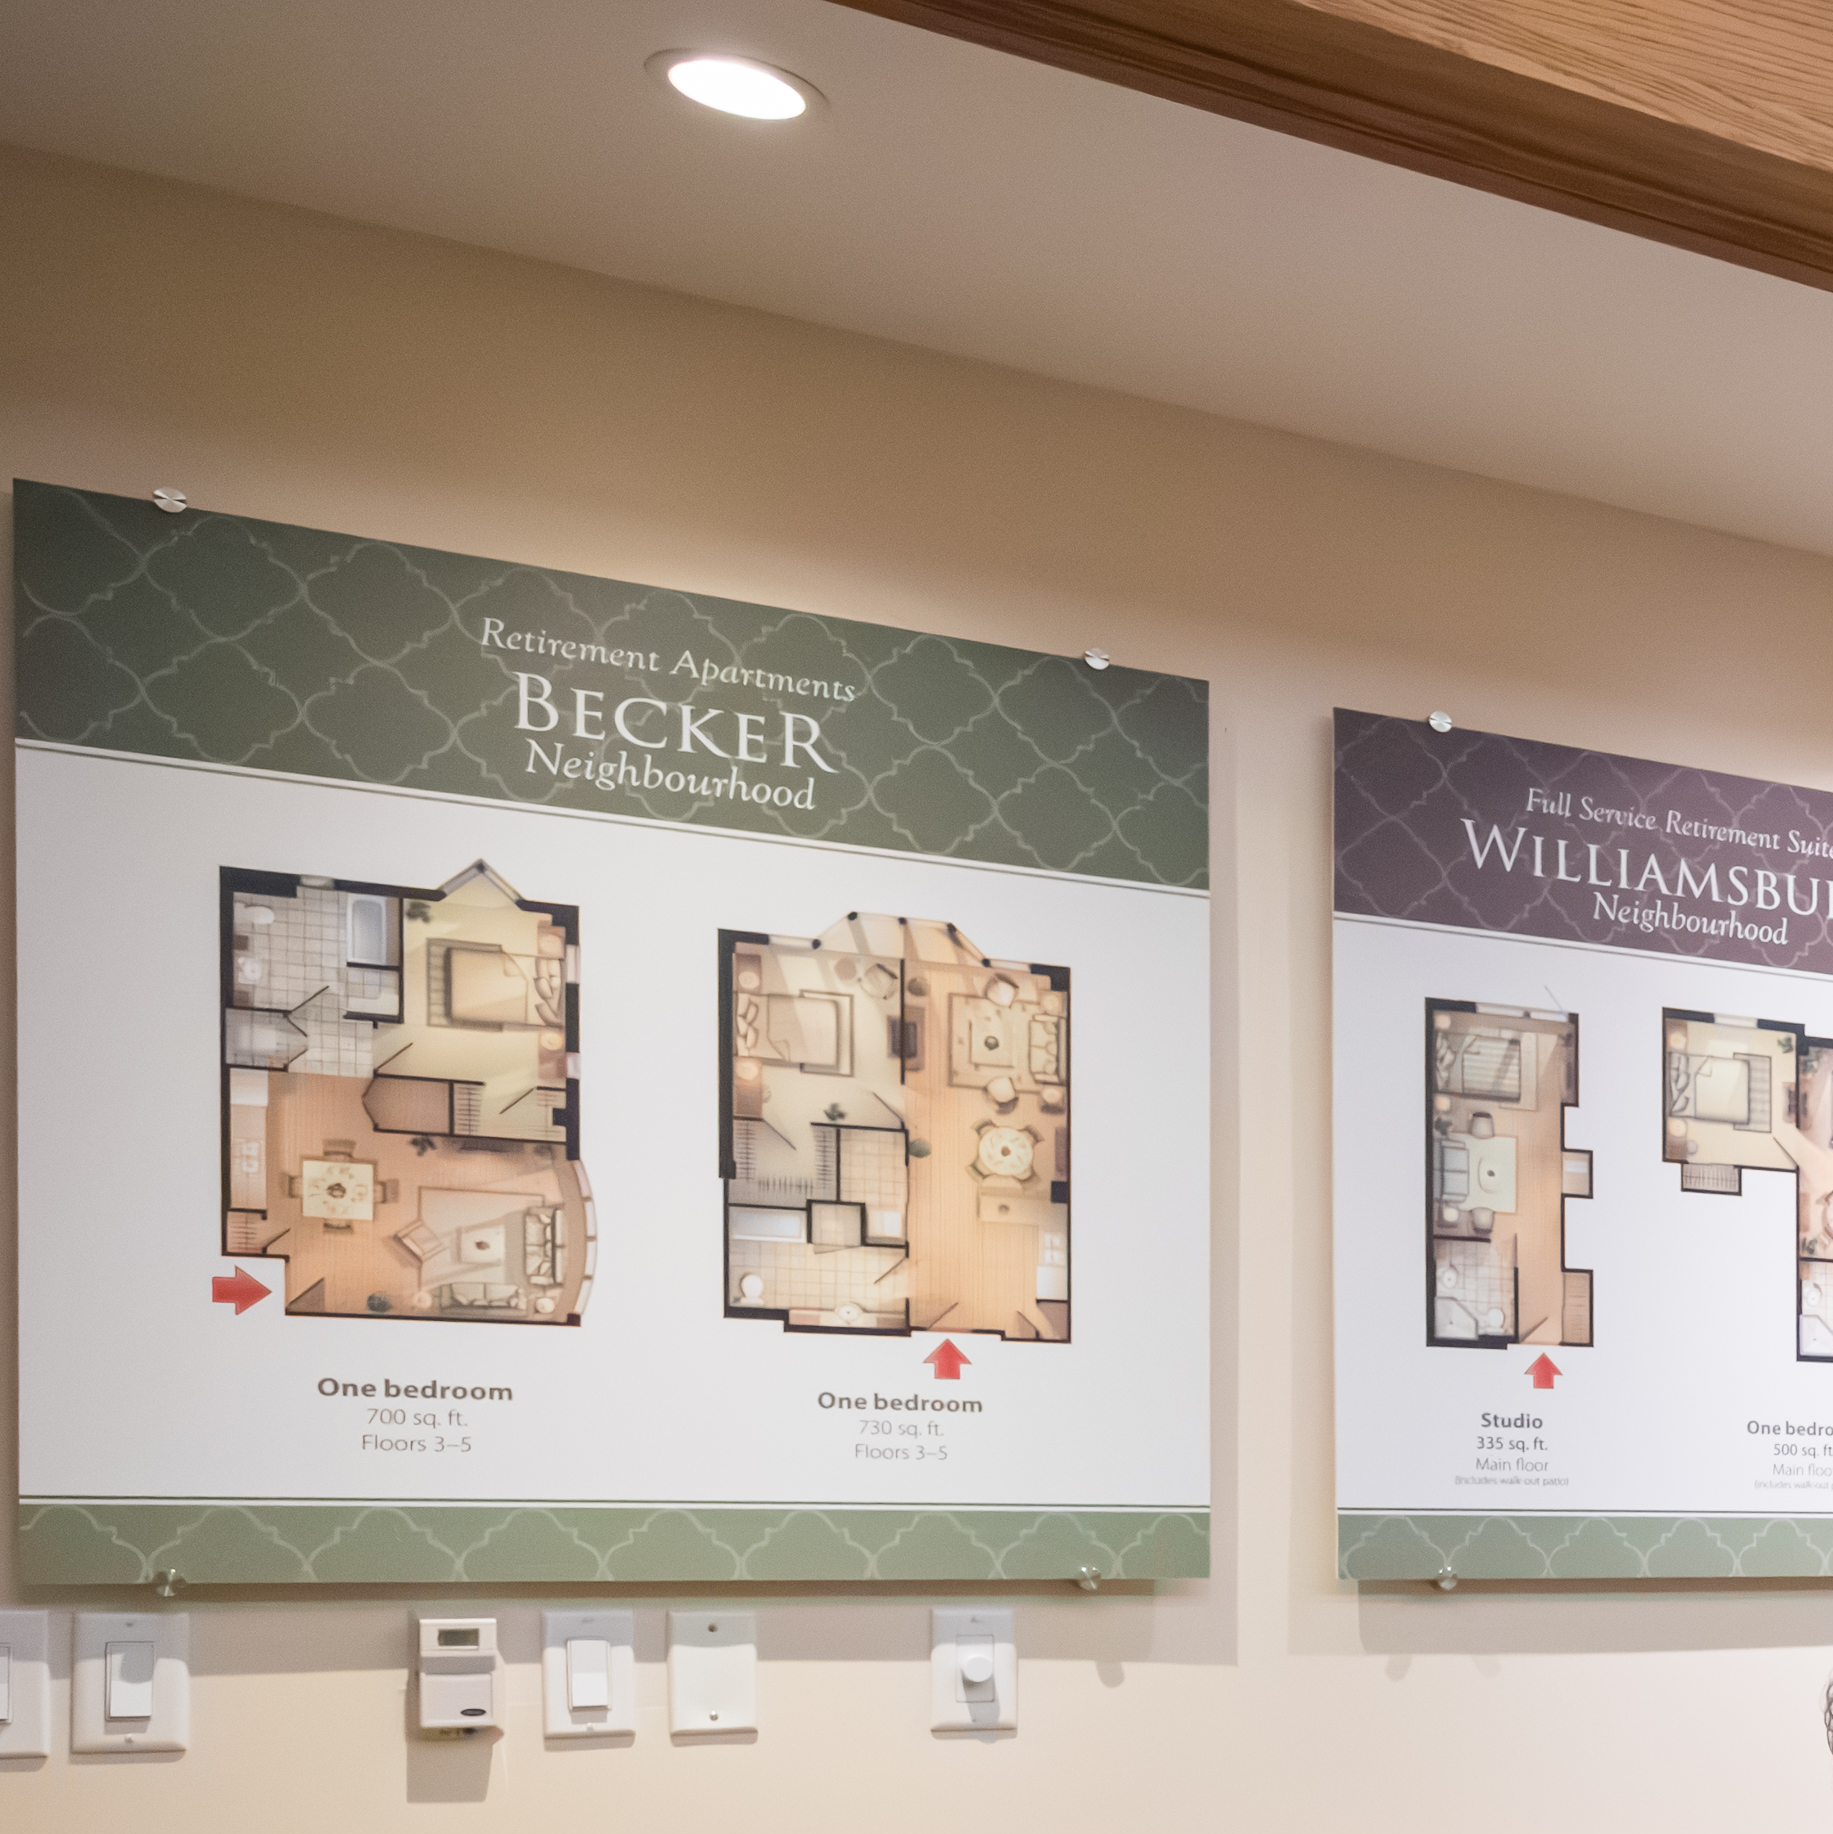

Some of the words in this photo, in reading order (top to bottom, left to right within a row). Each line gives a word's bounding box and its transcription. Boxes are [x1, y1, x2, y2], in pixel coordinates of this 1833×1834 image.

[480, 617, 660, 672] Retirement
[669, 650, 856, 702] Apartments
[513, 671, 840, 774] BECKER
[525, 738, 816, 810] Neighbourhood
[1526, 787, 1571, 819] Full
[1580, 796, 1657, 832] Service
[1666, 809, 1781, 851] Retirement
[1593, 890, 1789, 946] Neighbourhood
[317, 1377, 377, 1397] One
[384, 1378, 514, 1401] bedroom
[818, 1391, 867, 1410] One
[873, 1393, 983, 1413] bedroom
[366, 1408, 406, 1425] 700
[413, 1412, 441, 1429] sq.
[447, 1409, 468, 1426] ft.
[1480, 1412, 1544, 1429] Studio
[1746, 1420, 1781, 1435] One
[858, 1420, 892, 1436] 730
[898, 1422, 922, 1439] sq.
[927, 1420, 945, 1437] ft.
[362, 1434, 427, 1451] Floors
[855, 1443, 910, 1460] Floors
[1476, 1436, 1504, 1450] 335
[1508, 1439, 1529, 1453] sq.
[1533, 1436, 1548, 1451] ft.
[1773, 1443, 1798, 1456] 500
[1801, 1445, 1820, 1459] sq.
[1475, 1457, 1512, 1472] Main
[1516, 1457, 1549, 1473] floor
[1772, 1463, 1804, 1476] Main
